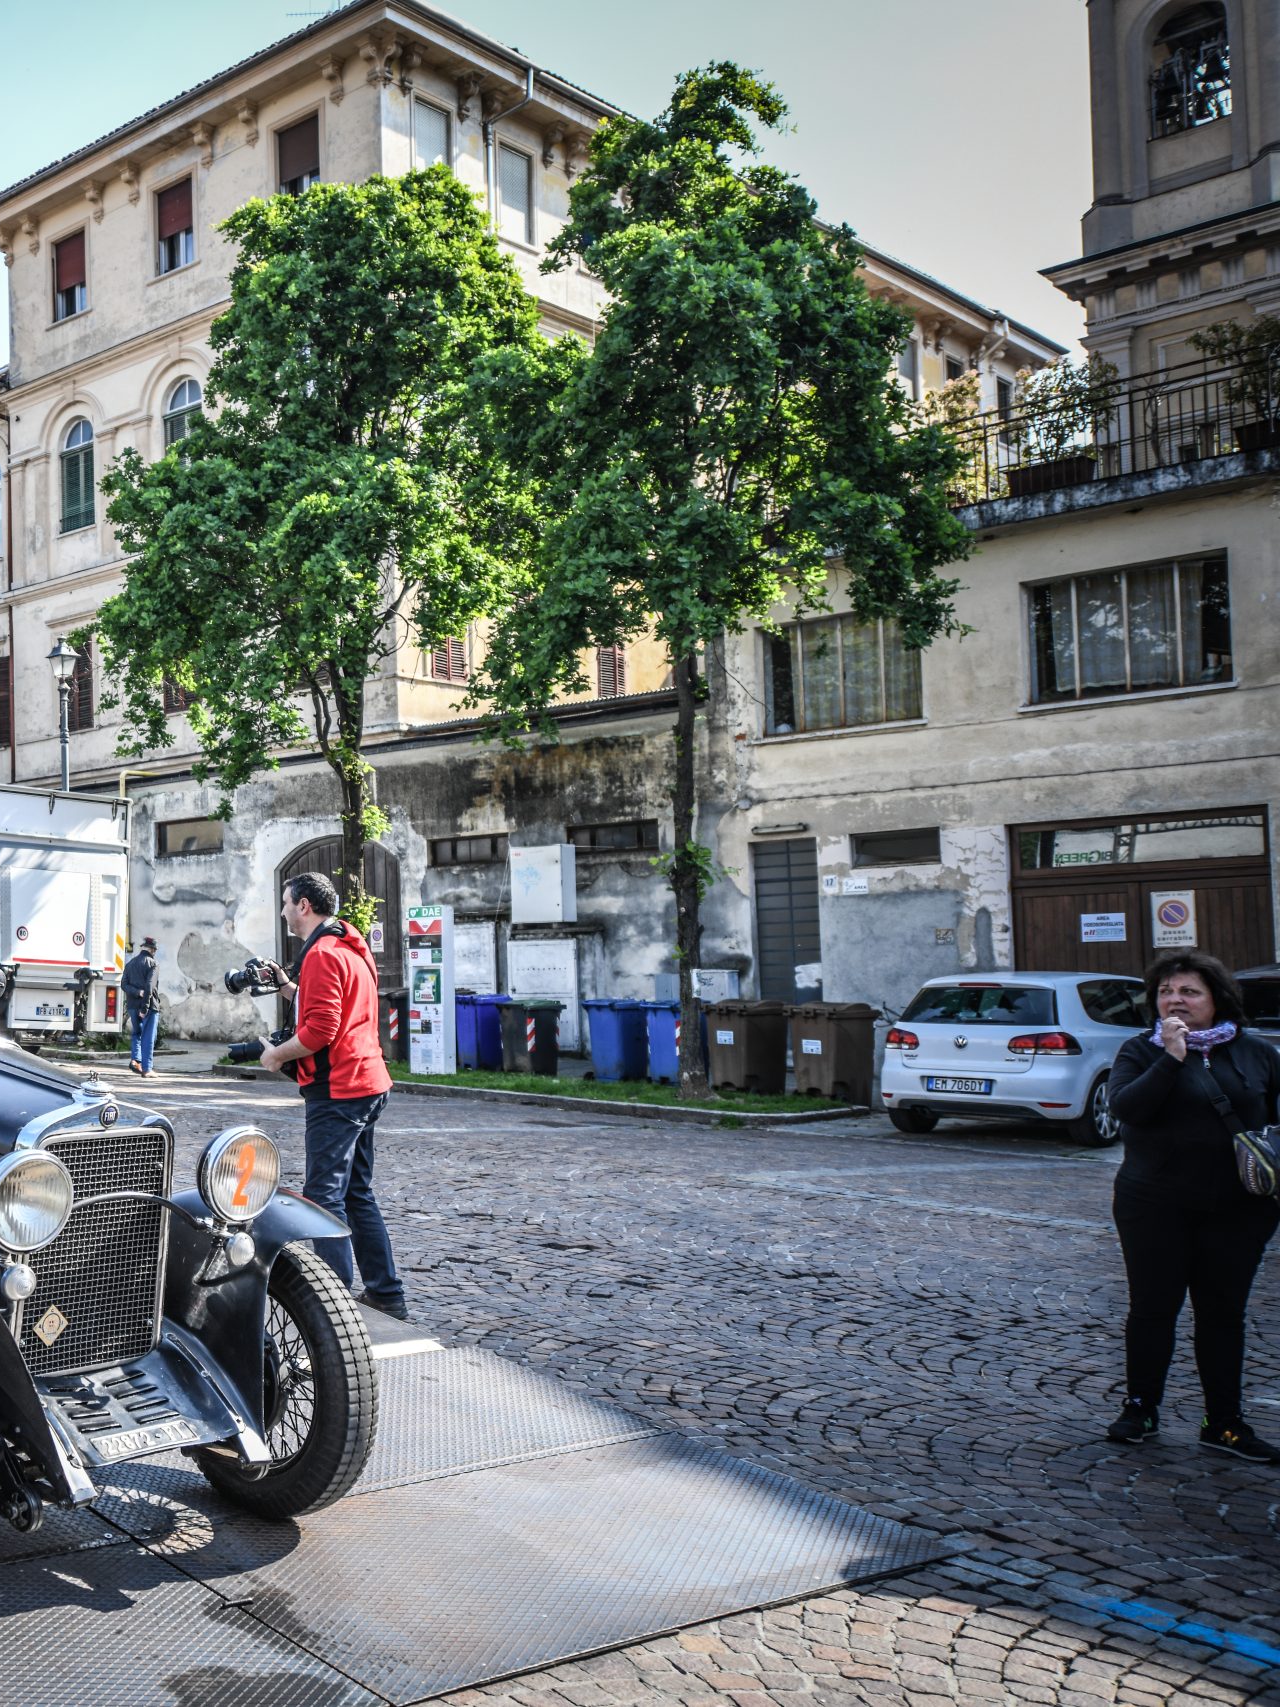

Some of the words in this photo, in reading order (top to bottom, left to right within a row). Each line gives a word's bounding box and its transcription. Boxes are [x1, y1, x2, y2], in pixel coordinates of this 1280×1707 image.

[422, 907, 441, 917] DAE
[934, 1078, 946, 1090] EM
[951, 1080, 984, 1092] 706DY
[104, 1110, 116, 1122] FIAT
[231, 1143, 256, 1206] 2
